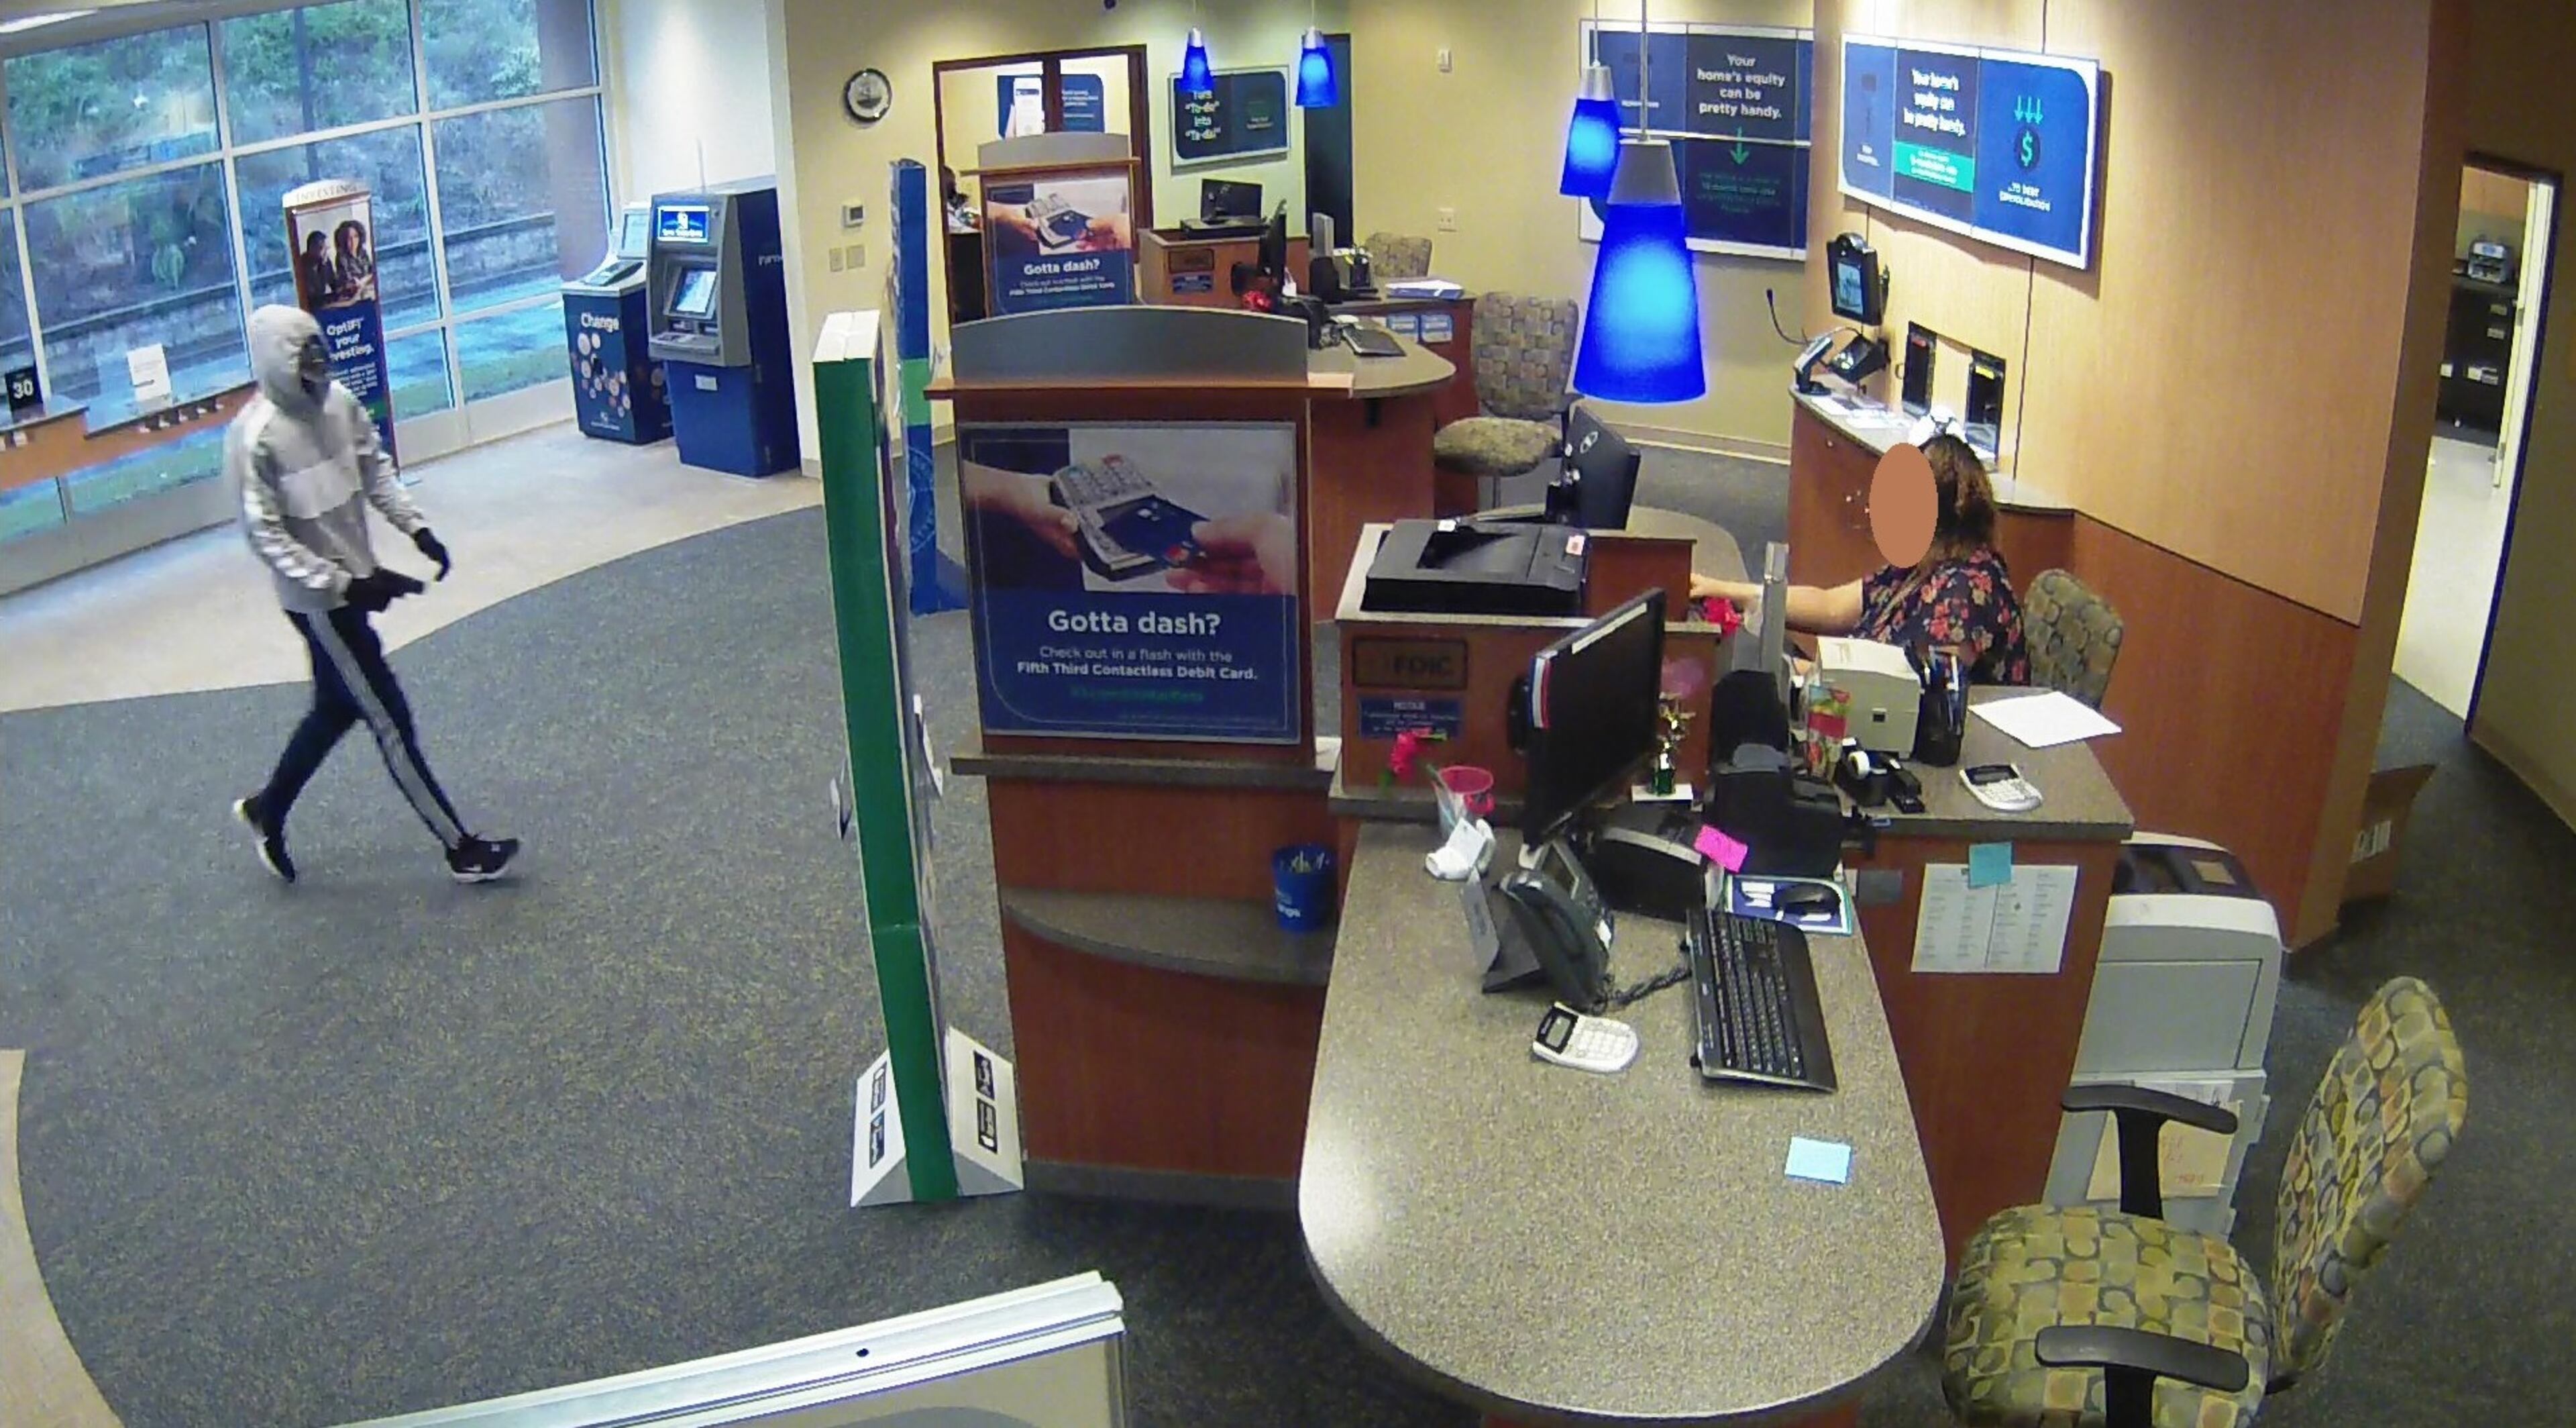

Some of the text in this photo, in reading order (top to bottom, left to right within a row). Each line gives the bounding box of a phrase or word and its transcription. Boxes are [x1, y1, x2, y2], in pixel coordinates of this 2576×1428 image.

[1727, 54, 1756, 66] Your
[1697, 68, 1786, 87] home's equity
[1719, 88, 1762, 100] can be
[1699, 102, 1782, 119] pretty handy.
[1024, 259, 1100, 276] Gotta dash?
[581, 312, 619, 333] Change
[13, 379, 34, 399] 30
[1049, 609, 1221, 635] Gotta dash?
[1040, 646, 1232, 663] Check out in a flash with the
[1017, 662, 1258, 680] Fifth Third Contactless Debit Card.
[1393, 656, 1451, 675] FDIC
